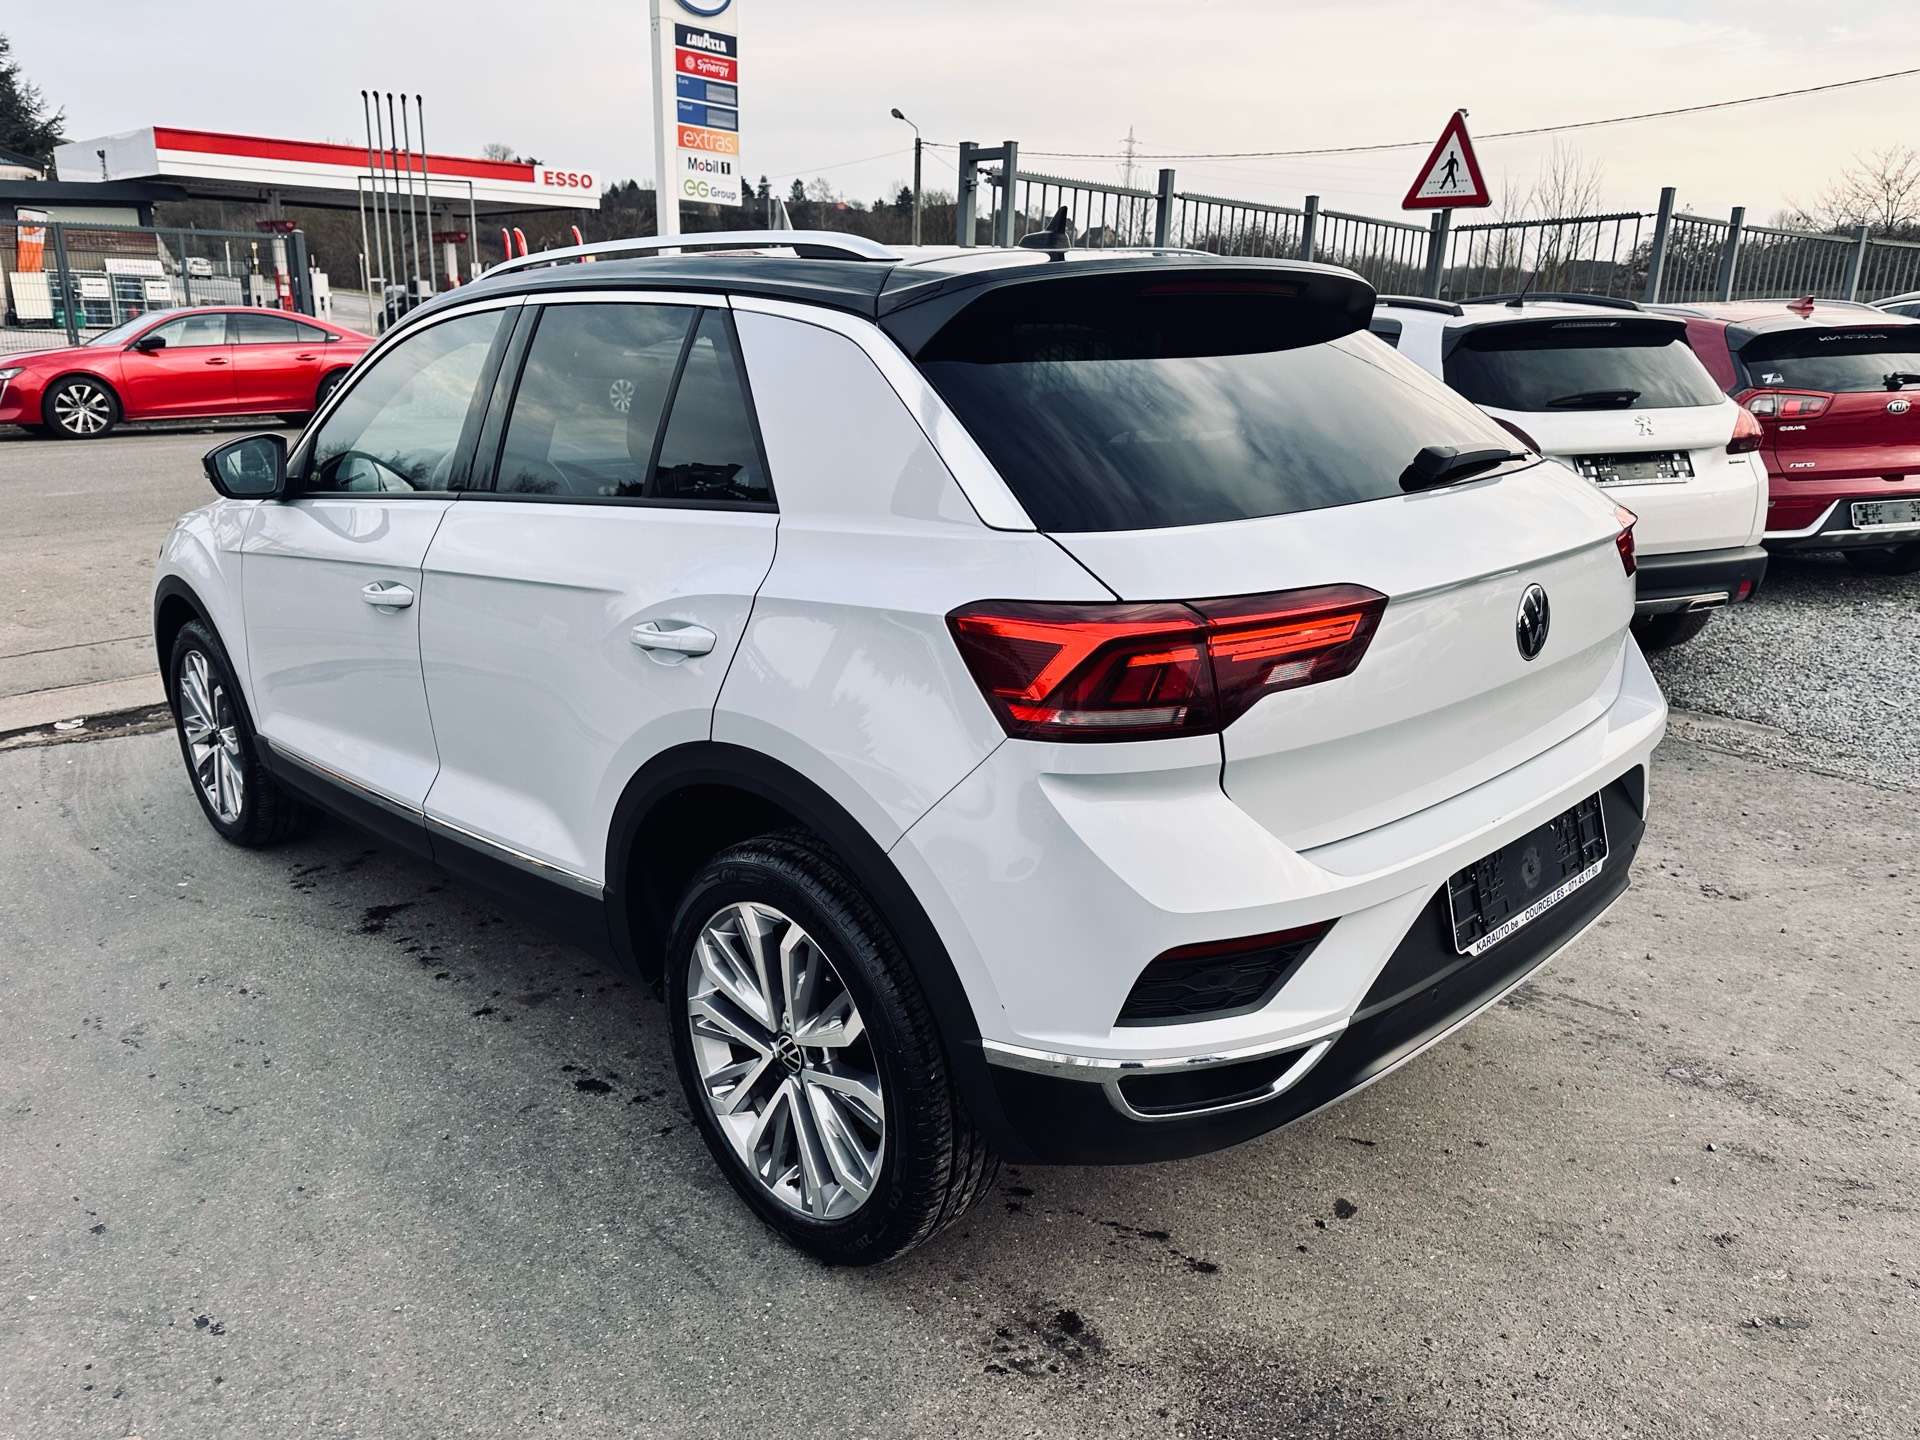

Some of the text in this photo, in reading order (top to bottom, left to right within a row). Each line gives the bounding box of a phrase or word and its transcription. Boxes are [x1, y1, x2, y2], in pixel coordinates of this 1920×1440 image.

[686, 33, 727, 53] LAVAZZA
[696, 59, 729, 77] Synergy
[688, 156, 719, 174] Mobil
[543, 171, 593, 189] ESSO
[710, 186, 737, 201] Group
[1887, 400, 1910, 415] KIA
[1476, 920, 1519, 953] KARAUTO.be
[1525, 887, 1565, 921] COURCELLES
